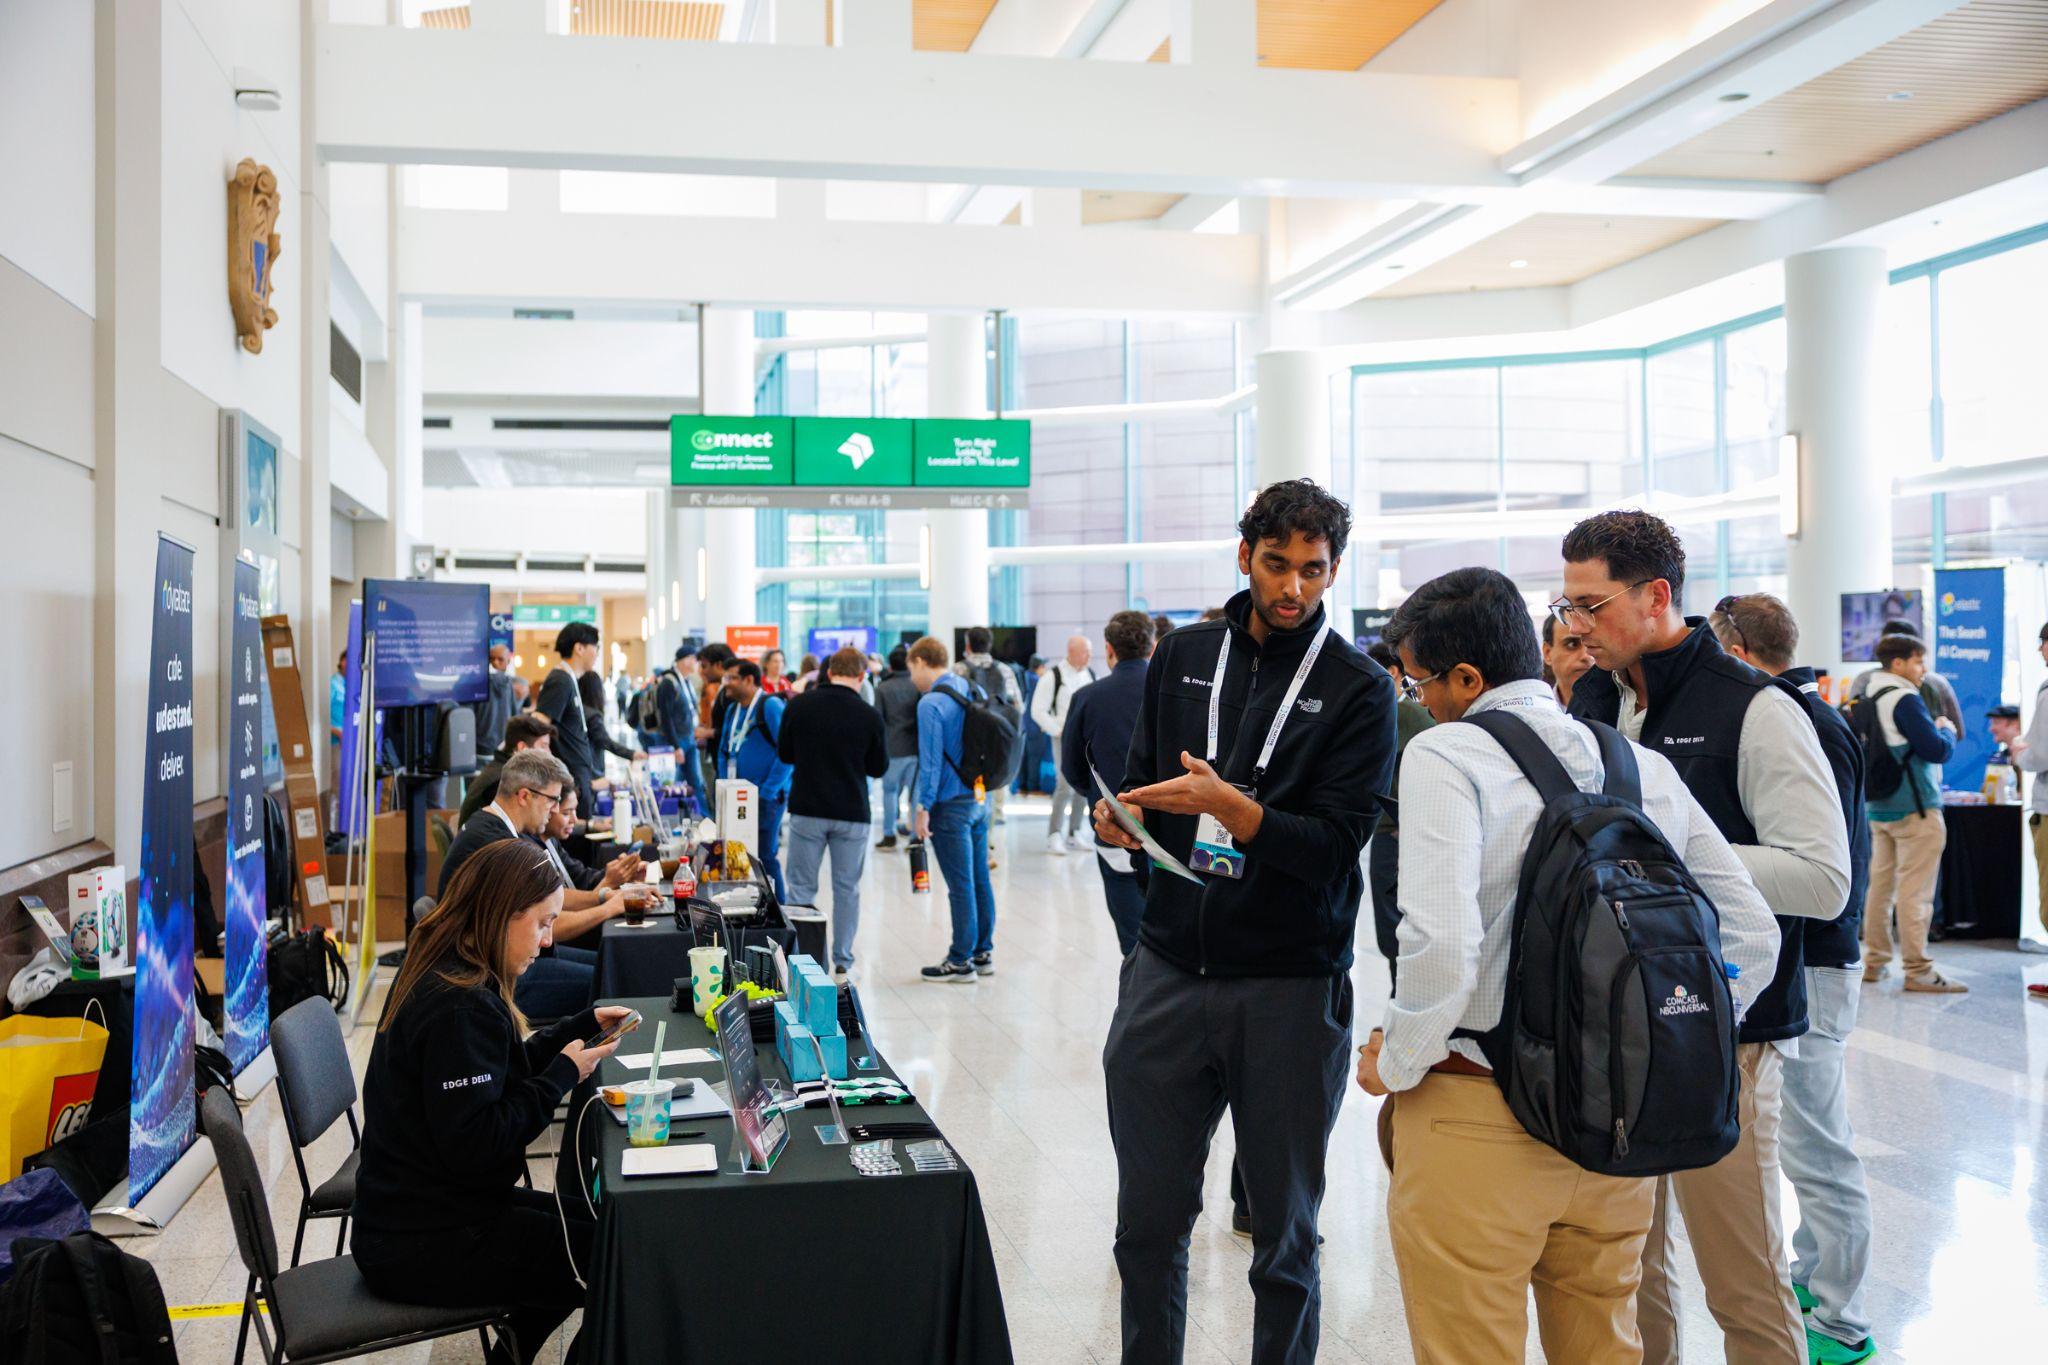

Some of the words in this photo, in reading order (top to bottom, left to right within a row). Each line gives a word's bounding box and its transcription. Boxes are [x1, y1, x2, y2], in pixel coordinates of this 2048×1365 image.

[707, 494, 769, 506] Auditorium
[845, 495, 868, 506] Hall
[950, 495, 972, 507] Hall
[1950, 645, 1991, 662] Company
[1666, 994, 1699, 1006] COMCAST
[1660, 1002, 1710, 1016] NBCUNIVERSAL
[443, 1078, 469, 1090] EDGE
[471, 1073, 492, 1085] DELTA
